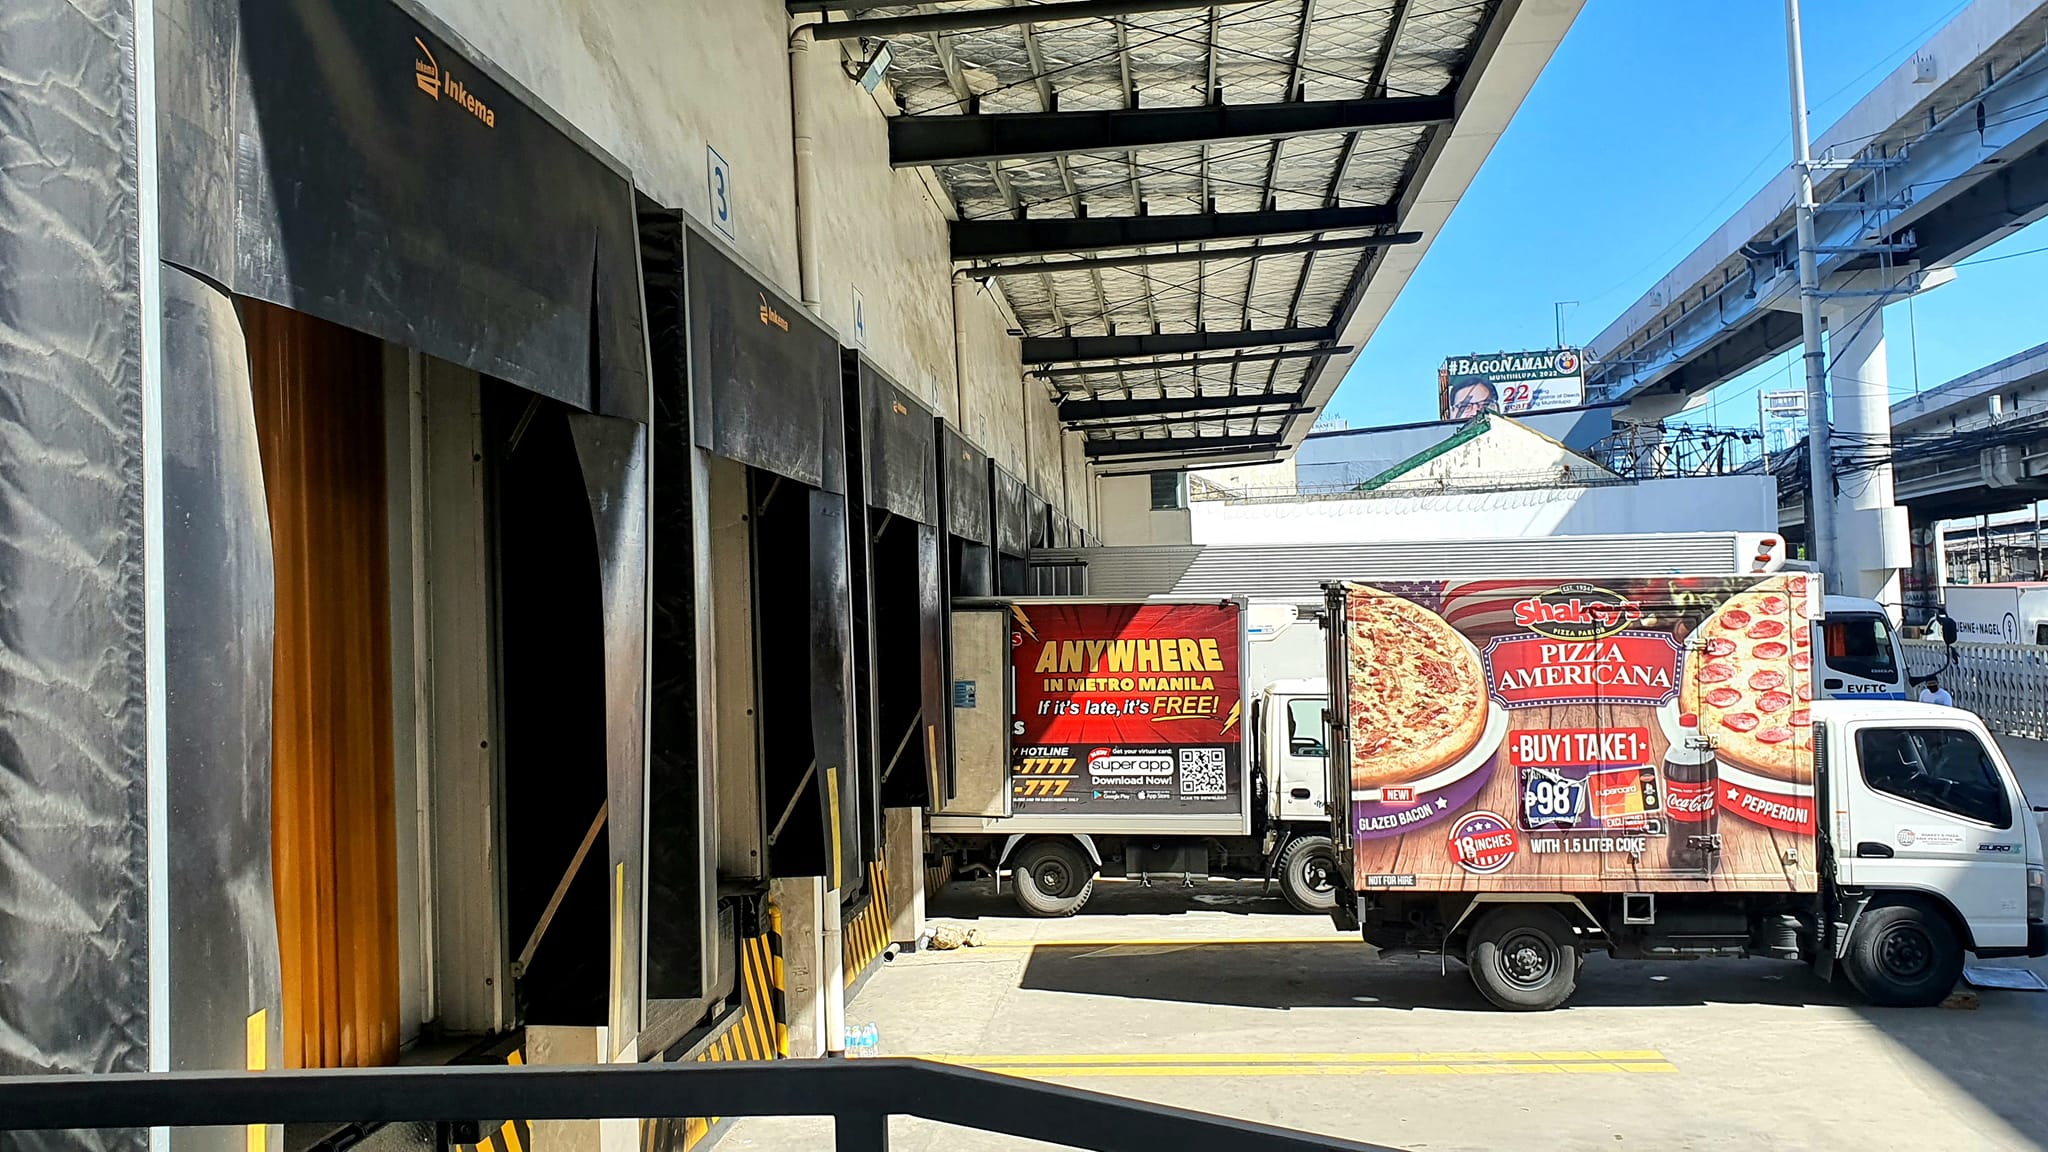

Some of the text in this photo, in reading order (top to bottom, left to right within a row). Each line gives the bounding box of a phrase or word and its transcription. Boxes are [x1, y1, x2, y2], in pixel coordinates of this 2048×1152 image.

[444, 70, 495, 128] Inkema
[715, 166, 728, 222] 3
[857, 299, 864, 337] 4
[1503, 384, 1529, 403] 22
[1955, 622, 2001, 635] UEHNE+NAGEL
[1034, 638, 1224, 673] ANYWHERE
[1539, 642, 1626, 665] PIZZA
[1043, 676, 1215, 692] IN METRO MANILA
[1498, 664, 1672, 692] AMERICANA
[1847, 684, 1887, 693] EVFTC
[1037, 696, 1219, 717] If it's late, it's FREE!
[1020, 747, 1070, 756] HOTLINE
[1092, 760, 1171, 773] super app
[1092, 776, 1173, 785] Download Now!
[1387, 789, 1409, 801] NEW!
[1358, 803, 1434, 832] GLAZED BACON
[1741, 793, 1808, 824] PEPPERONI
[1475, 833, 1513, 852] INCHES
[1530, 837, 1646, 853] WITH 1.5 LITER COKE
[1979, 844, 2011, 852] EURO
[1368, 875, 1415, 886] NOT FOR HIRE
